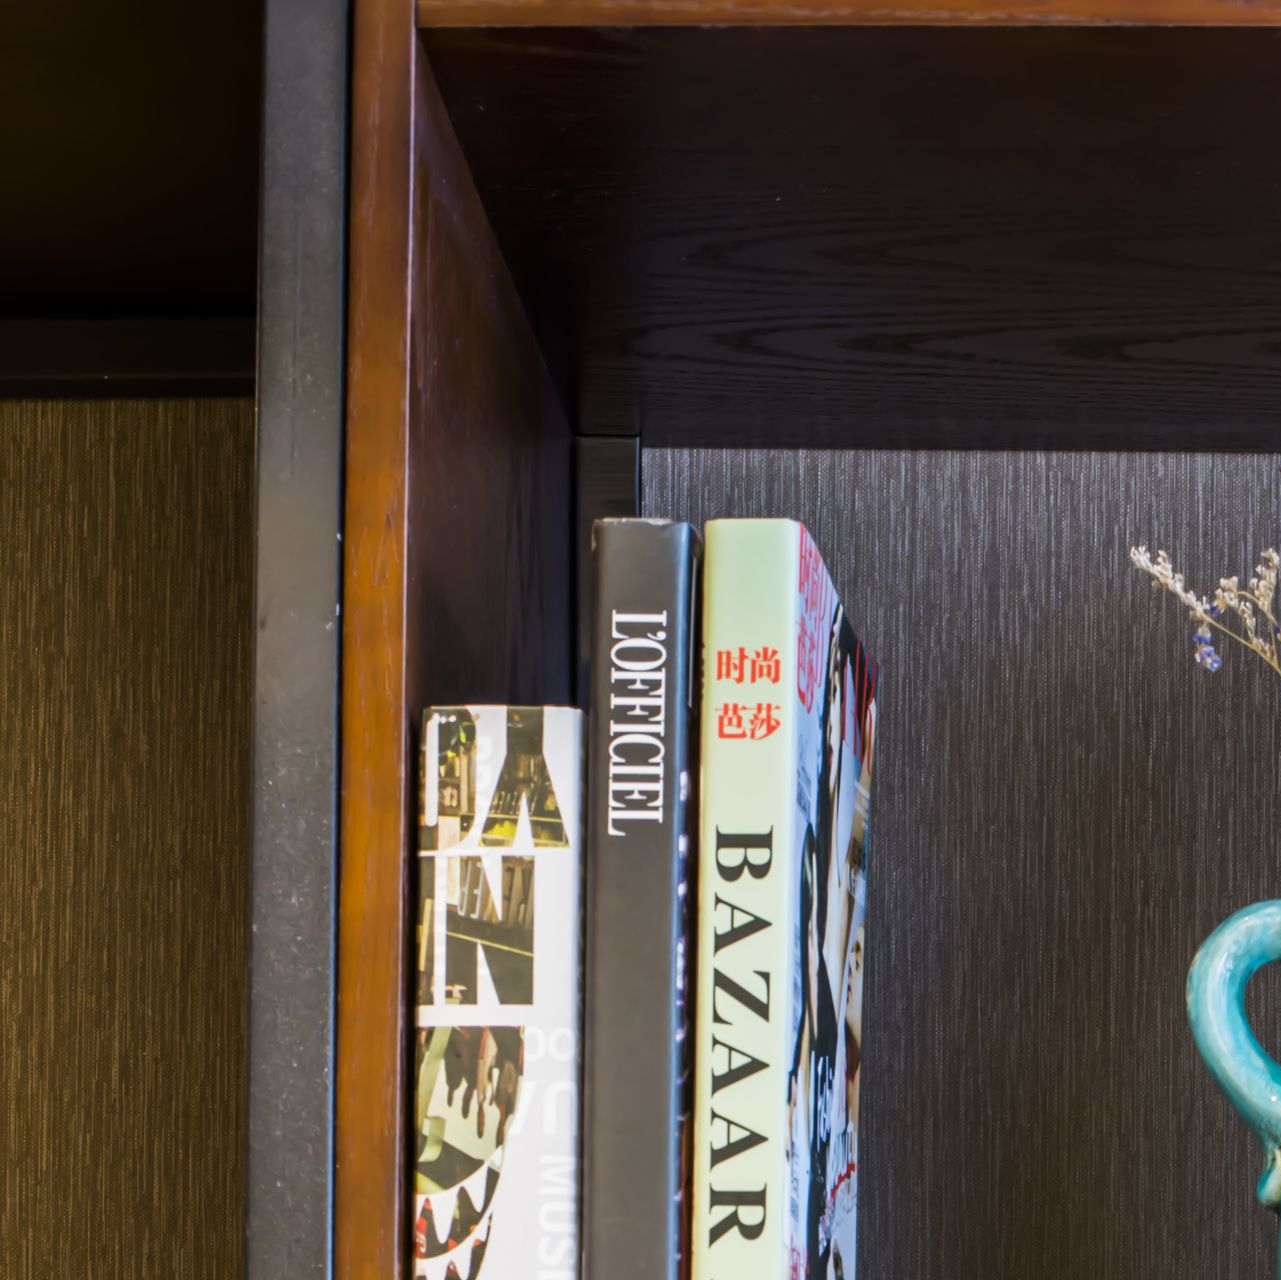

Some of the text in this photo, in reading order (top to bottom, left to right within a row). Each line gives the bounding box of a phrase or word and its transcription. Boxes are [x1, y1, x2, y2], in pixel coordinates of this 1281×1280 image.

[607, 609, 668, 837] L'OFFICIEL
[713, 703, 782, 740] 芭莎
[715, 646, 781, 685] 时尚
[707, 823, 774, 1250] BAZAAR
